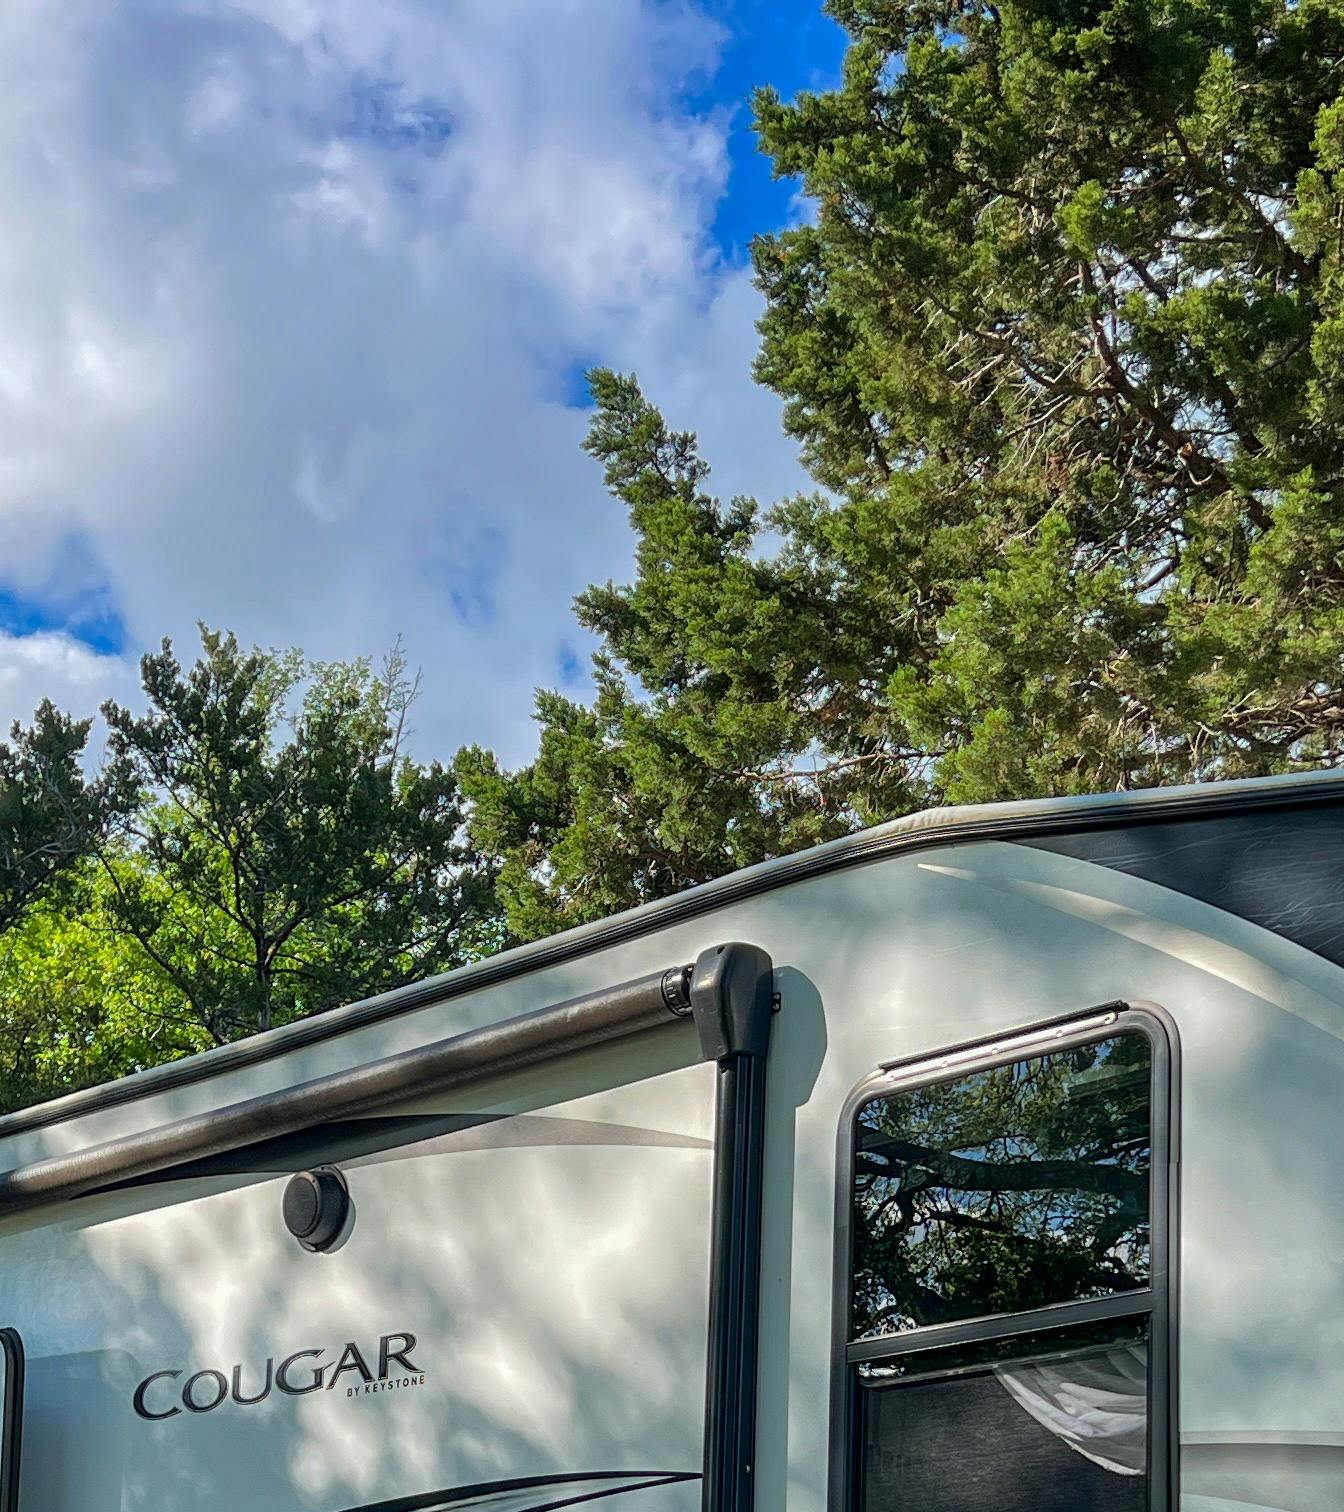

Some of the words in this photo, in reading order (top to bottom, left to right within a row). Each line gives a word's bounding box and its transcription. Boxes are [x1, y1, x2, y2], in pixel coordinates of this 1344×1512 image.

[133, 1332, 425, 1420] COUGAR
[346, 1386, 360, 1397] BY
[364, 1375, 425, 1394] KEYSTONE
